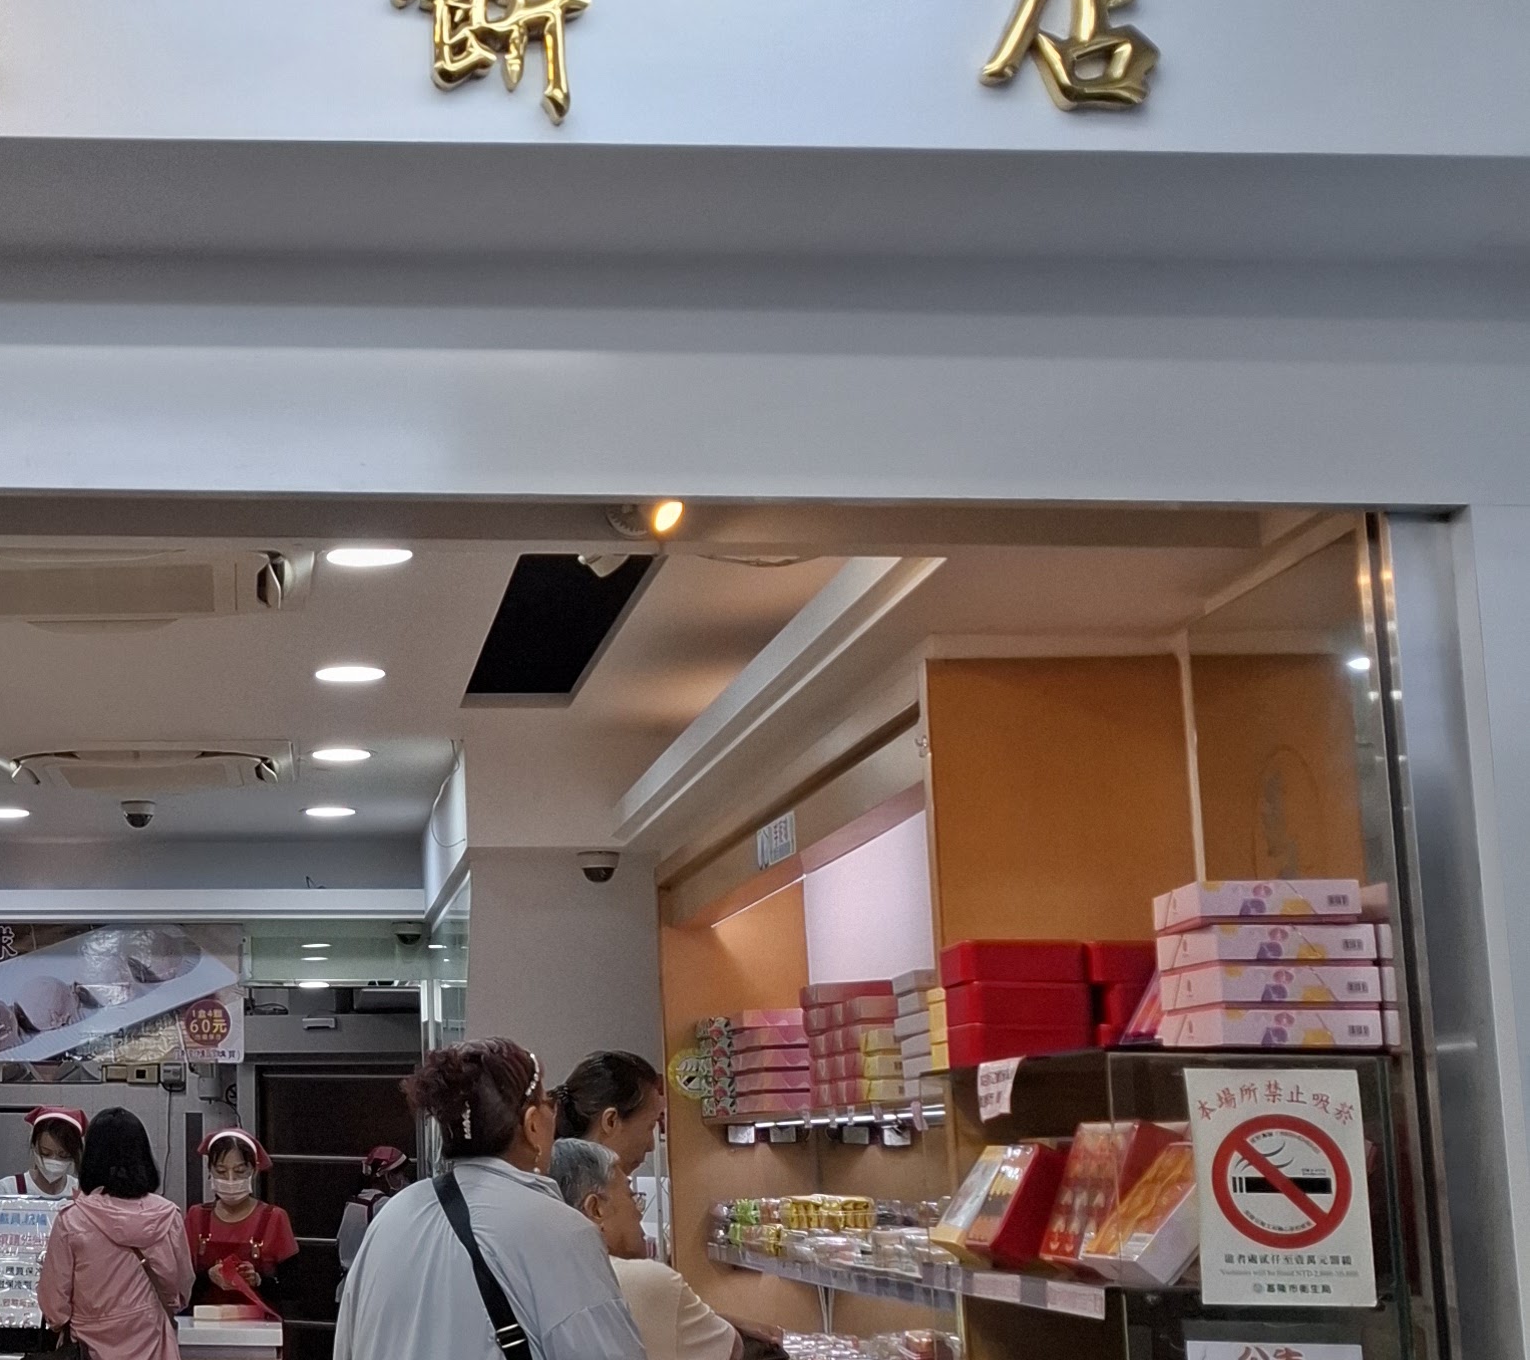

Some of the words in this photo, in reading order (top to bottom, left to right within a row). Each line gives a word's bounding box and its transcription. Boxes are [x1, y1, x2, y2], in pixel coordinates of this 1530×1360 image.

[189, 1019, 228, 1033] 60元
[1197, 1079, 1355, 1125] 本場所禁止吸菸
